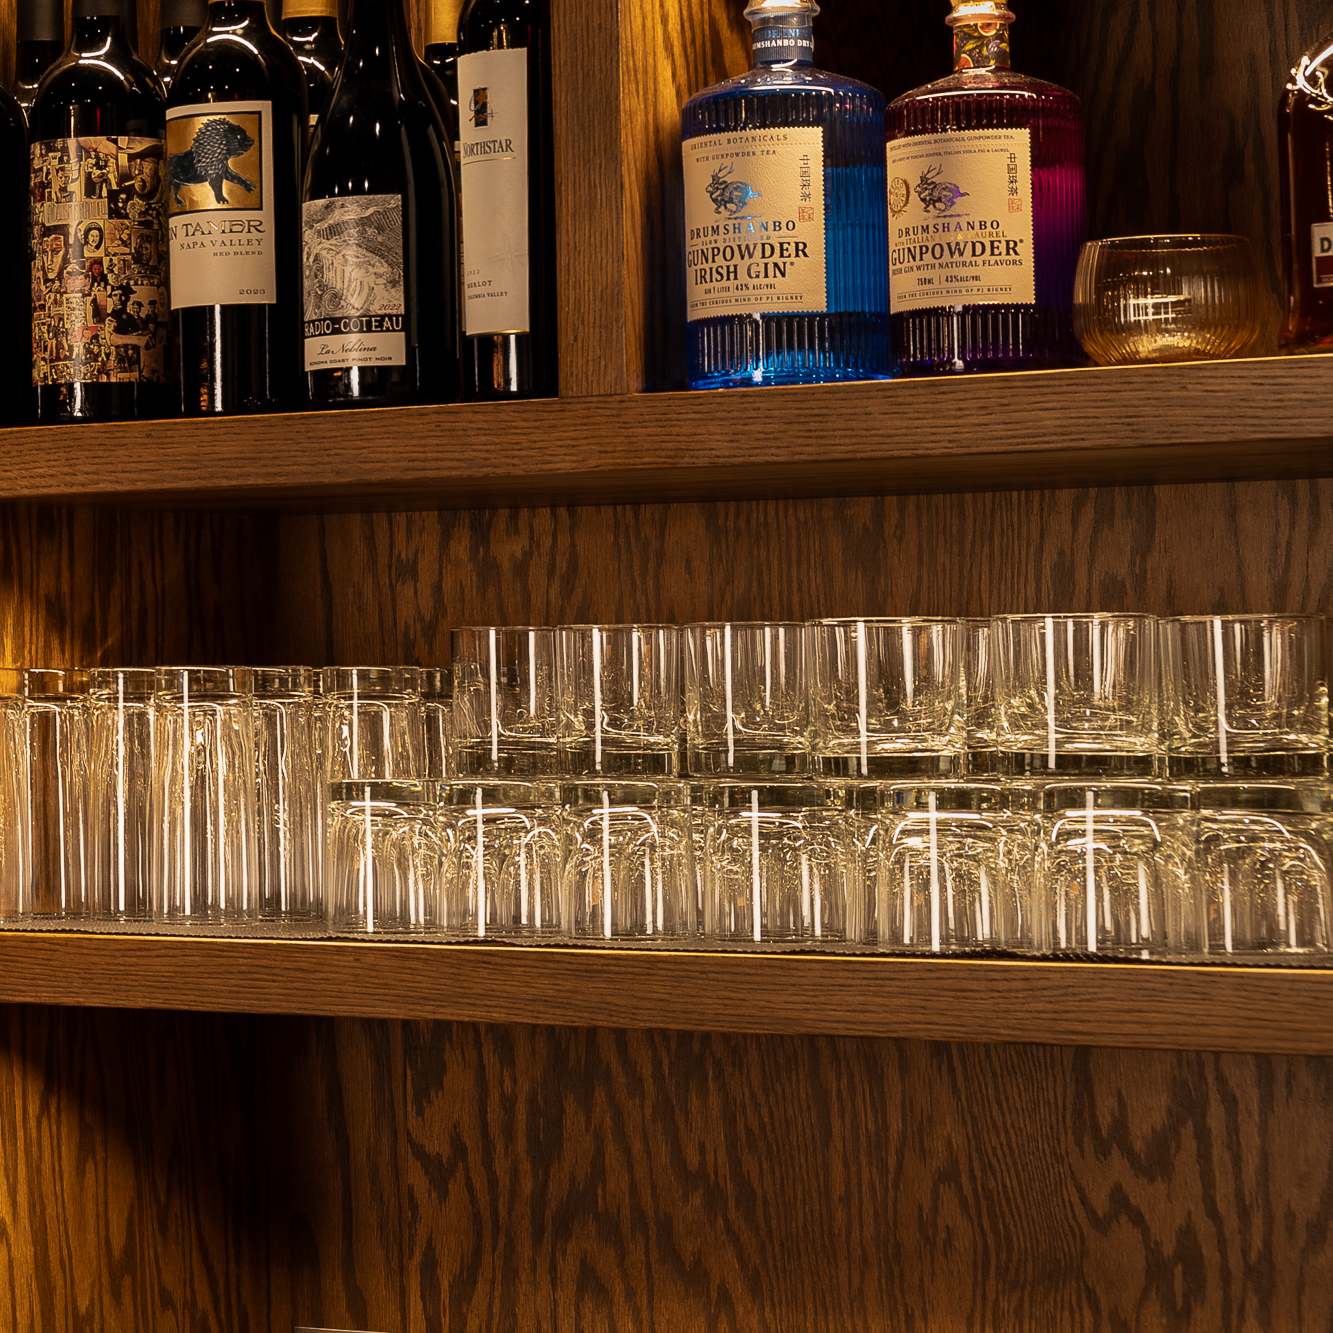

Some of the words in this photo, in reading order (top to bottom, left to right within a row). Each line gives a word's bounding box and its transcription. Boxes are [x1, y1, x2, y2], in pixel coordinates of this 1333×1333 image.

[727, 133, 788, 145] BOTANICALS
[463, 138, 514, 159] NORTHSTAR
[711, 150, 756, 160] GUNPOWDER
[181, 219, 265, 237] TAMER
[690, 220, 796, 240] DRUMSHANBO
[898, 220, 1000, 239] DRUMSHANBO
[179, 241, 206, 250] NAPA
[210, 238, 263, 247] VALLEY
[905, 234, 936, 246] ITALIAN
[968, 230, 1008, 240] LAUREL
[687, 241, 809, 268] GUNPOWDER
[891, 240, 1020, 267] GUNPOWDER
[694, 264, 739, 286] IRISH
[746, 261, 787, 279] GIN
[915, 263, 936, 272] WITH
[938, 259, 980, 270] NATURAL
[982, 259, 1023, 267] FLAVORS
[467, 280, 493, 289] MERLOT
[735, 283, 750, 292] 43%
[708, 298, 733, 306] CURIOUS
[918, 290, 944, 298] CURIOUS
[378, 303, 402, 311] 2022
[304, 316, 402, 336] RADIO-COTEAU
[317, 343, 331, 355] La
[331, 339, 378, 354] Neblina
